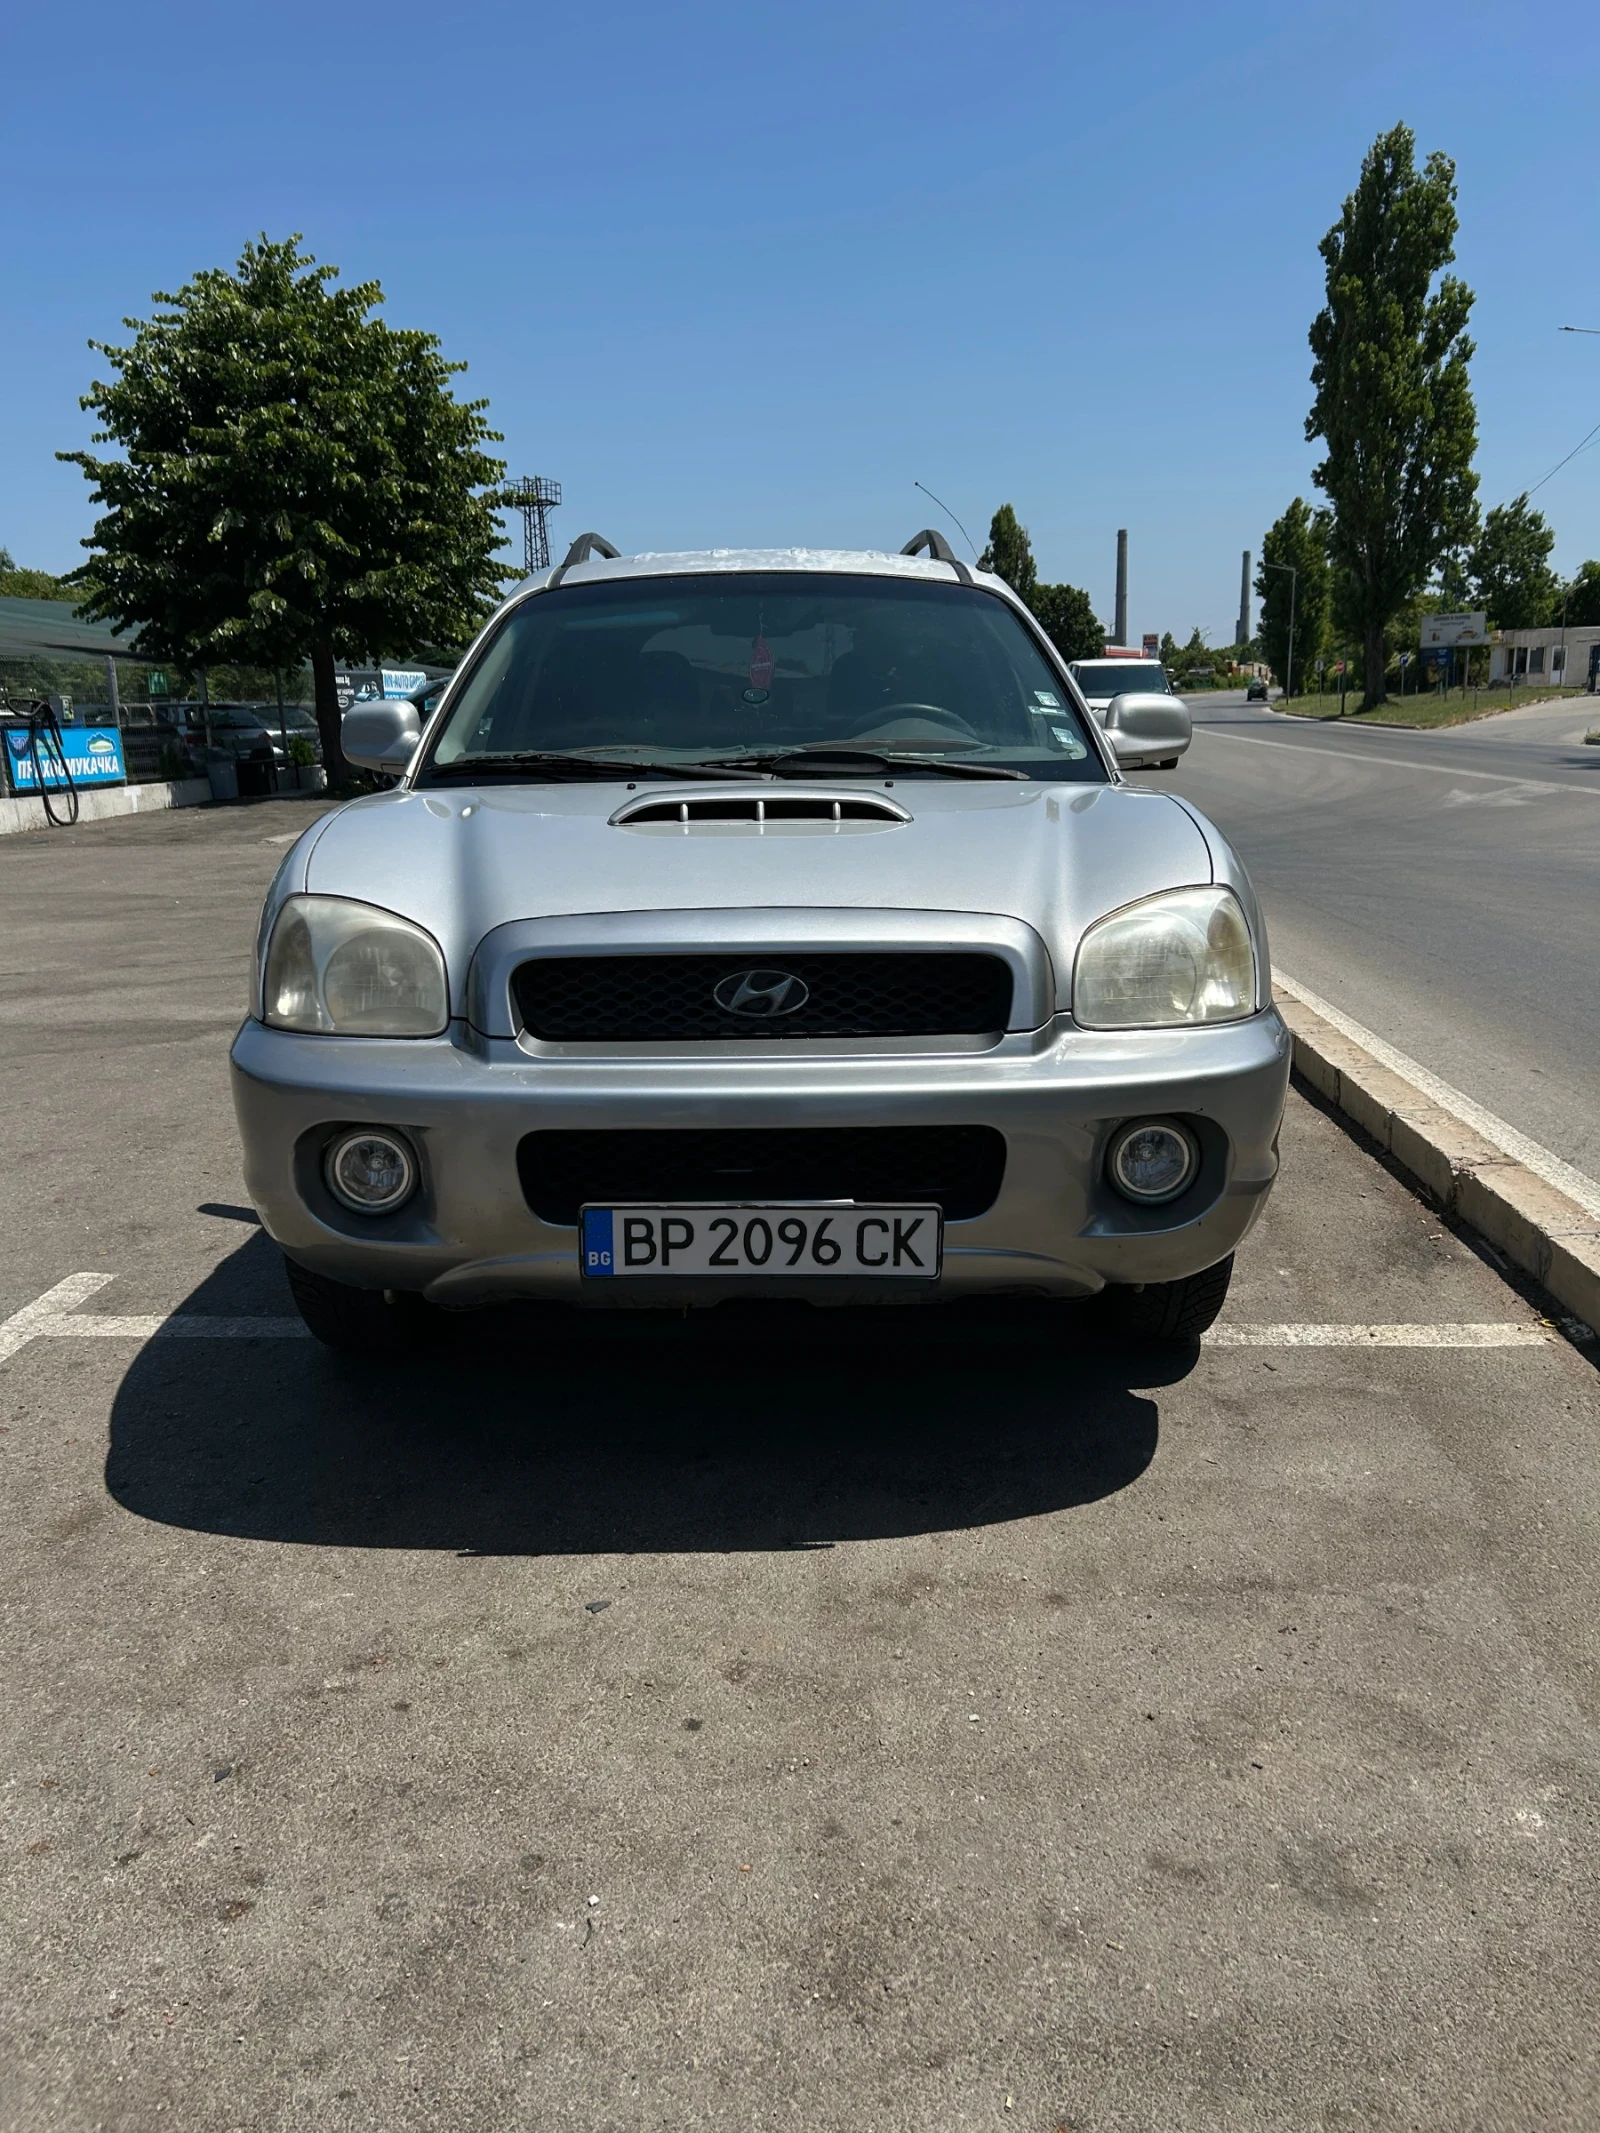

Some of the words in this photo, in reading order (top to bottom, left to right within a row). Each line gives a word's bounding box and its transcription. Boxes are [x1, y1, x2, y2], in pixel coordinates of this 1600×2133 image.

[588, 1251, 611, 1266] BG
[623, 1218, 694, 1267] BP
[708, 1218, 842, 1267] 2096
[856, 1218, 925, 1267] CK
